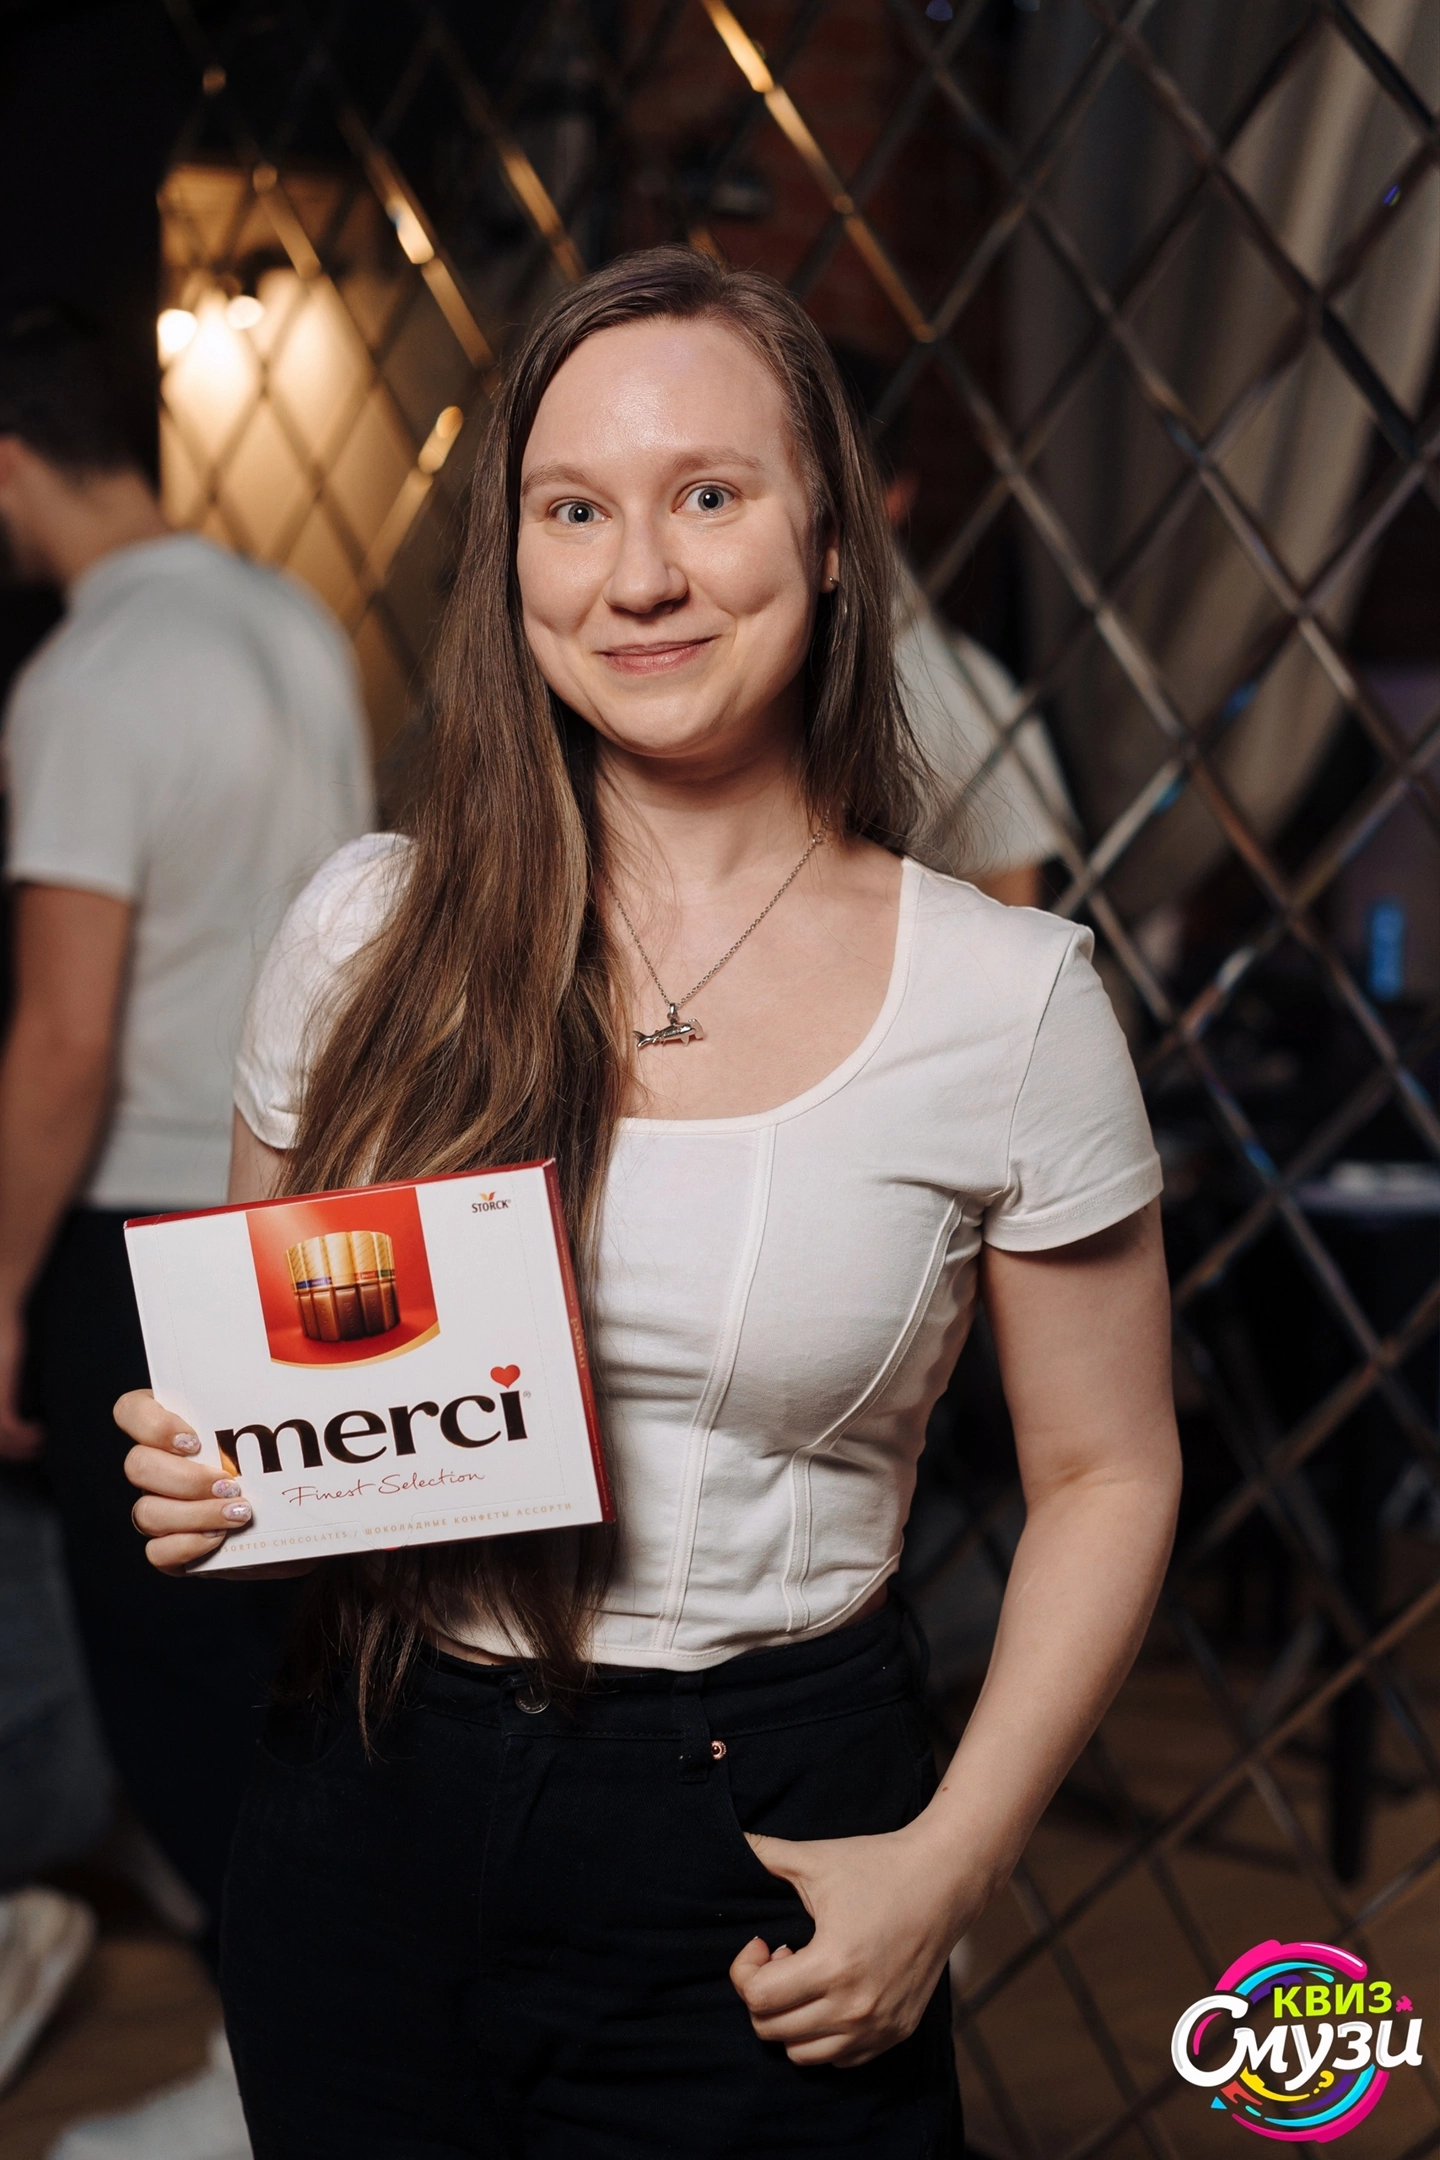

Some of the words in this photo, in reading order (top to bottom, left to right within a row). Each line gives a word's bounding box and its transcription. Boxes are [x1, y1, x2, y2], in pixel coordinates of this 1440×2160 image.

[471, 1200, 509, 1213] STORCK
[214, 1364, 528, 1476] merci
[282, 1479, 375, 1506] Finest
[378, 1468, 485, 1494] Selection
[364, 1518, 447, 1535] ШОКОЛАДНЫЕ
[454, 1511, 510, 1524] КОНФЕТЫ
[516, 1502, 572, 1516] АССОРТИ
[219, 1541, 266, 1553] SORTED
[273, 1531, 348, 1547] CHOCOLATES
